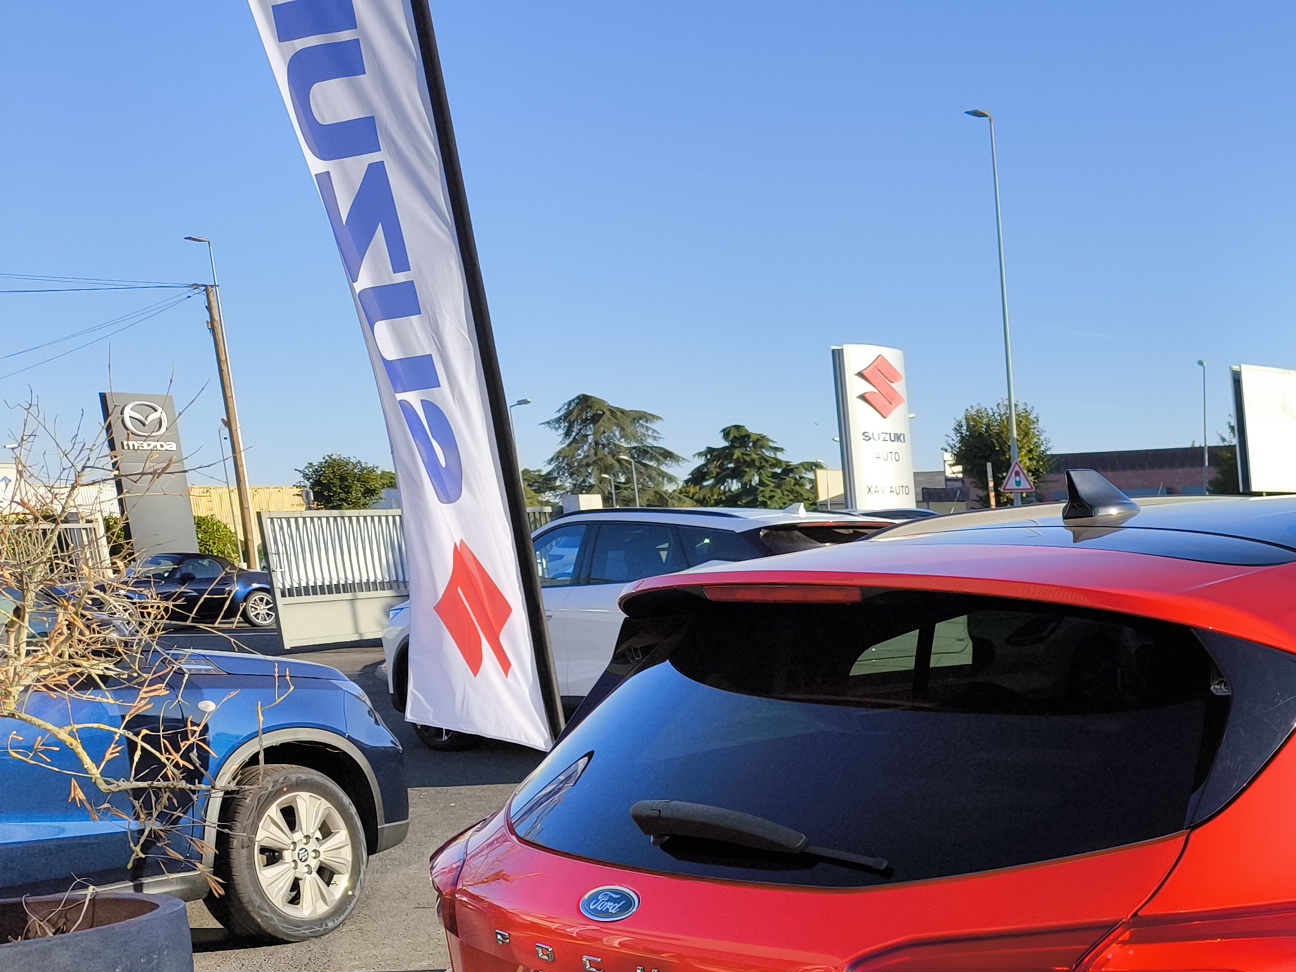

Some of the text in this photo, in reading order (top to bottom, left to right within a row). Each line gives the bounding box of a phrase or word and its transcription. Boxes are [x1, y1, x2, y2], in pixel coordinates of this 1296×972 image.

[861, 431, 906, 443] SUZUKI
[122, 440, 177, 451] mazda
[875, 451, 901, 462] AUTO
[889, 484, 910, 496] AUTO
[589, 889, 622, 915] Ford
